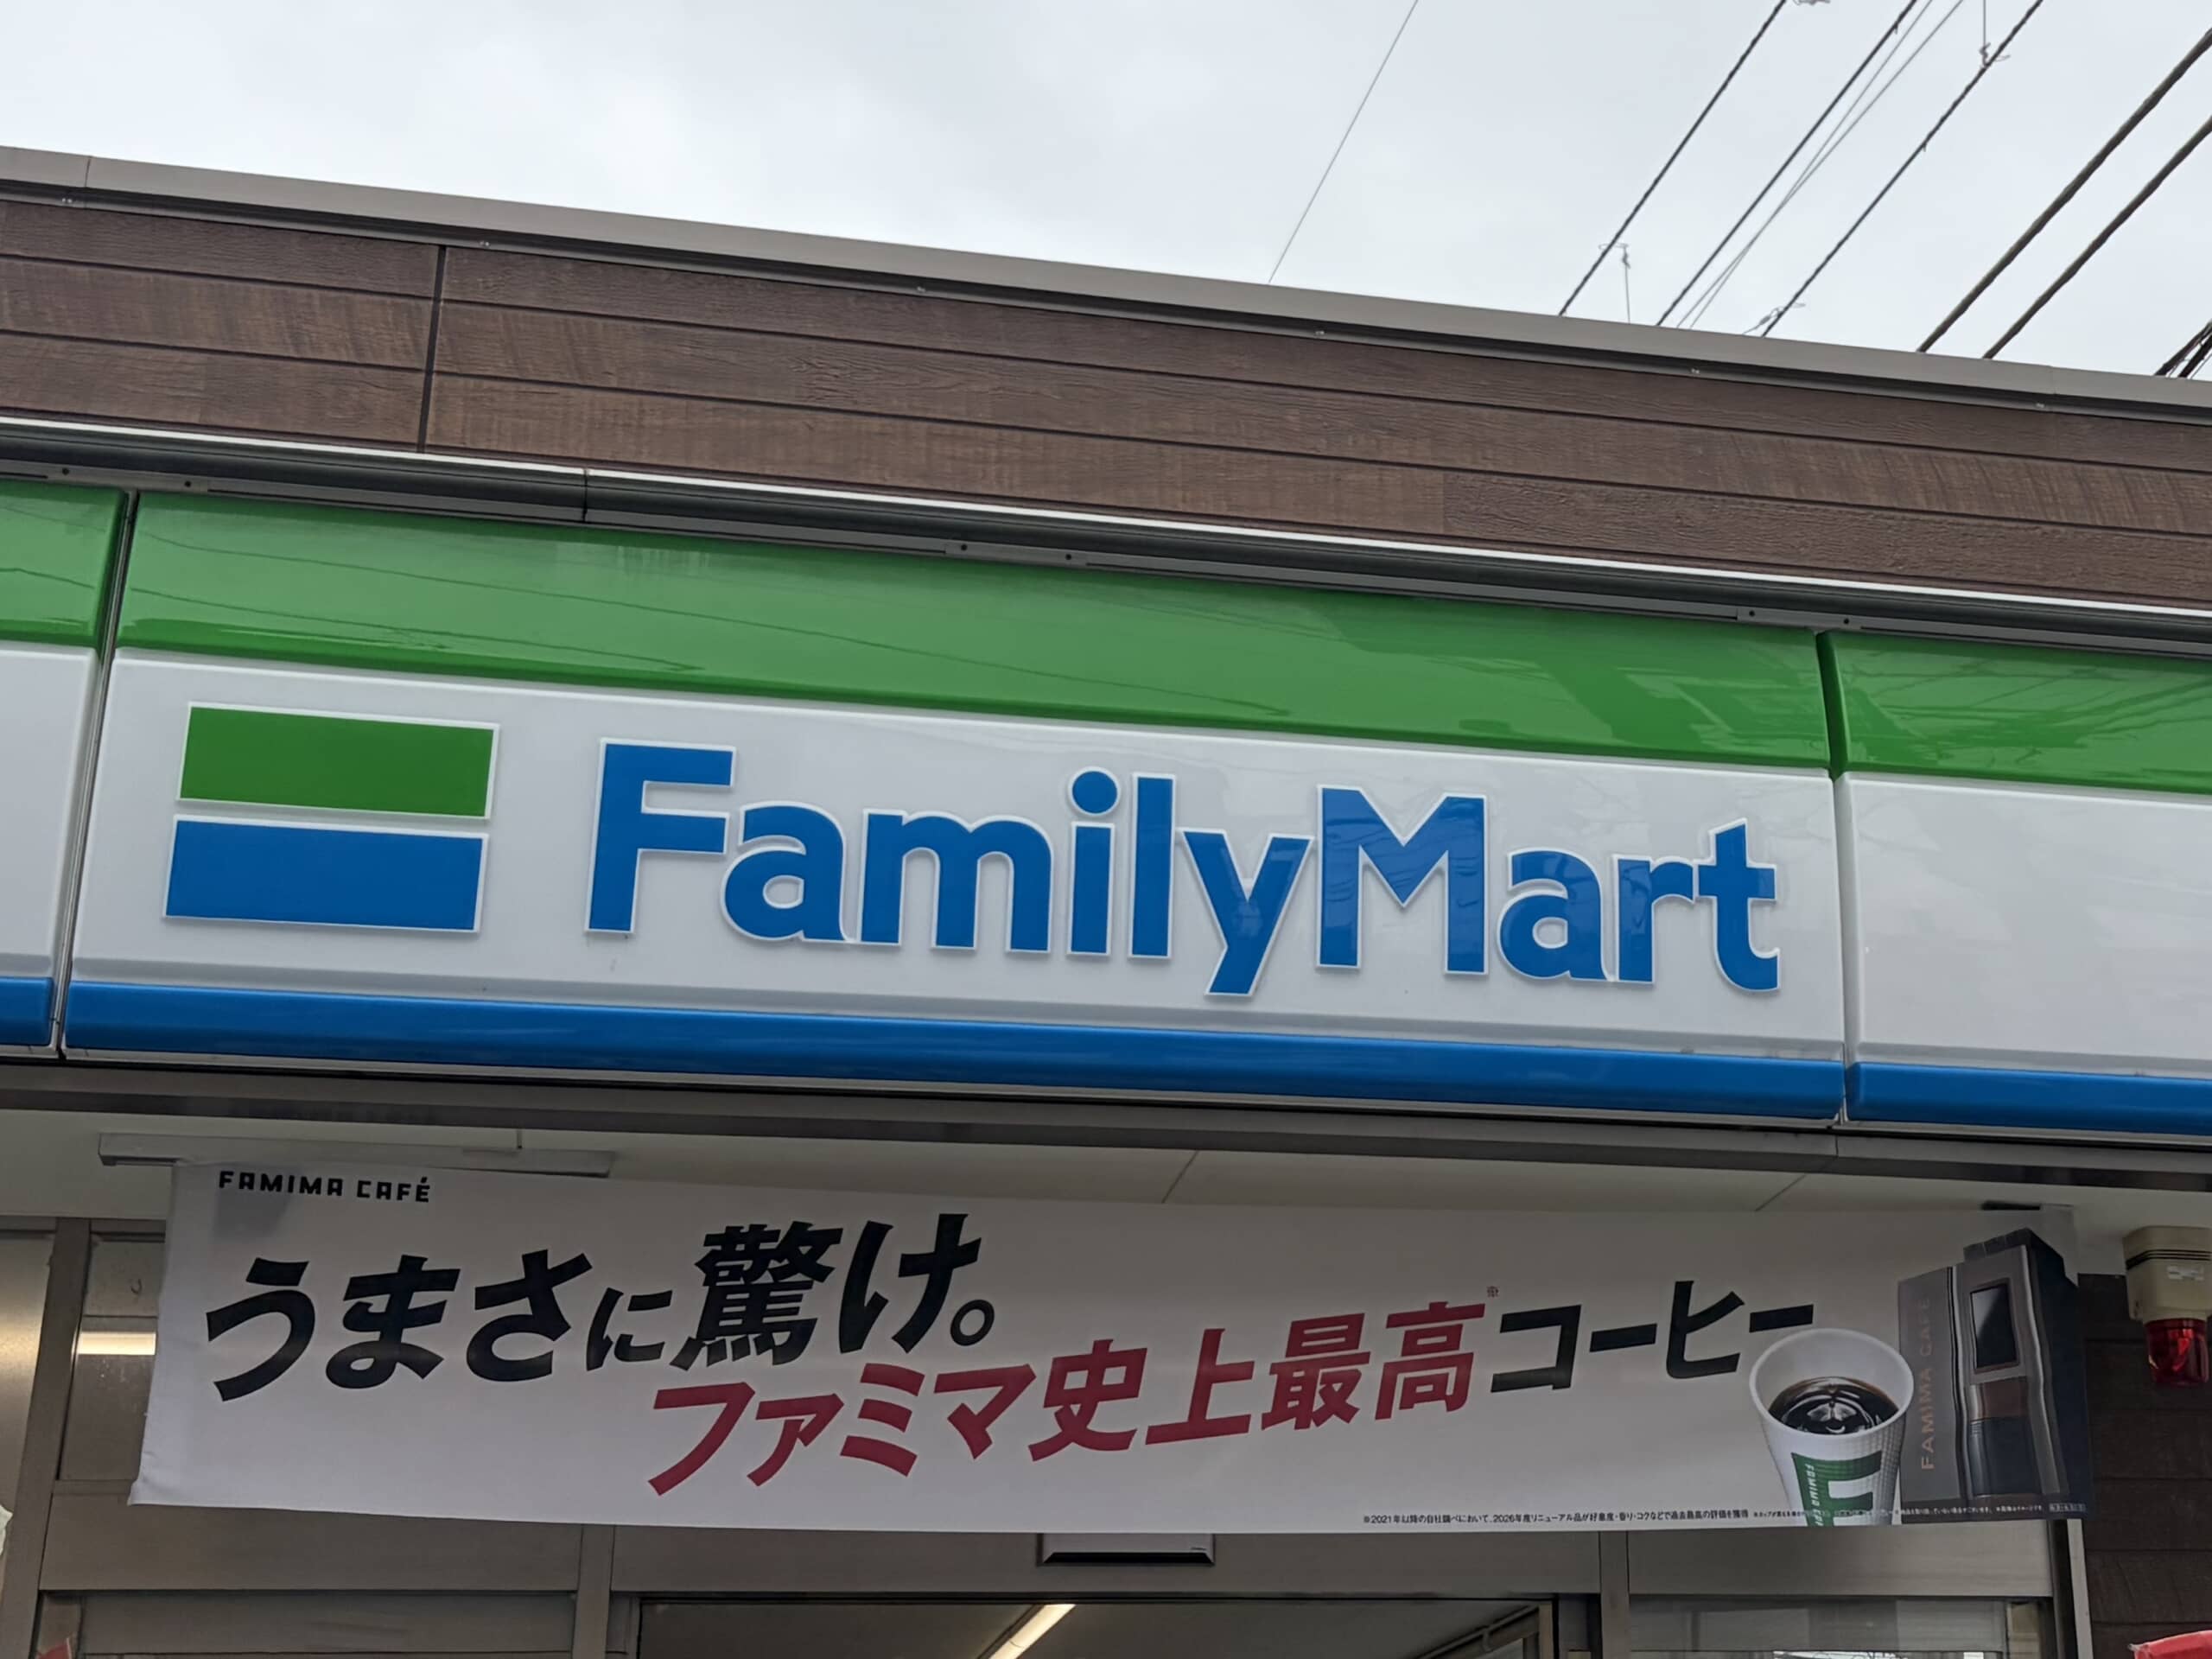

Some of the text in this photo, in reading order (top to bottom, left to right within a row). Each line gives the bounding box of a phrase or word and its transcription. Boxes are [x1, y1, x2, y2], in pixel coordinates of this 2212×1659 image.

[588, 744, 1778, 995] FamilyMart
[218, 1169, 431, 1204] FAMIMA CAFÉ
[206, 1212, 995, 1402] うまさに驚け。
[1919, 1368, 1936, 1471] FAMIMA
